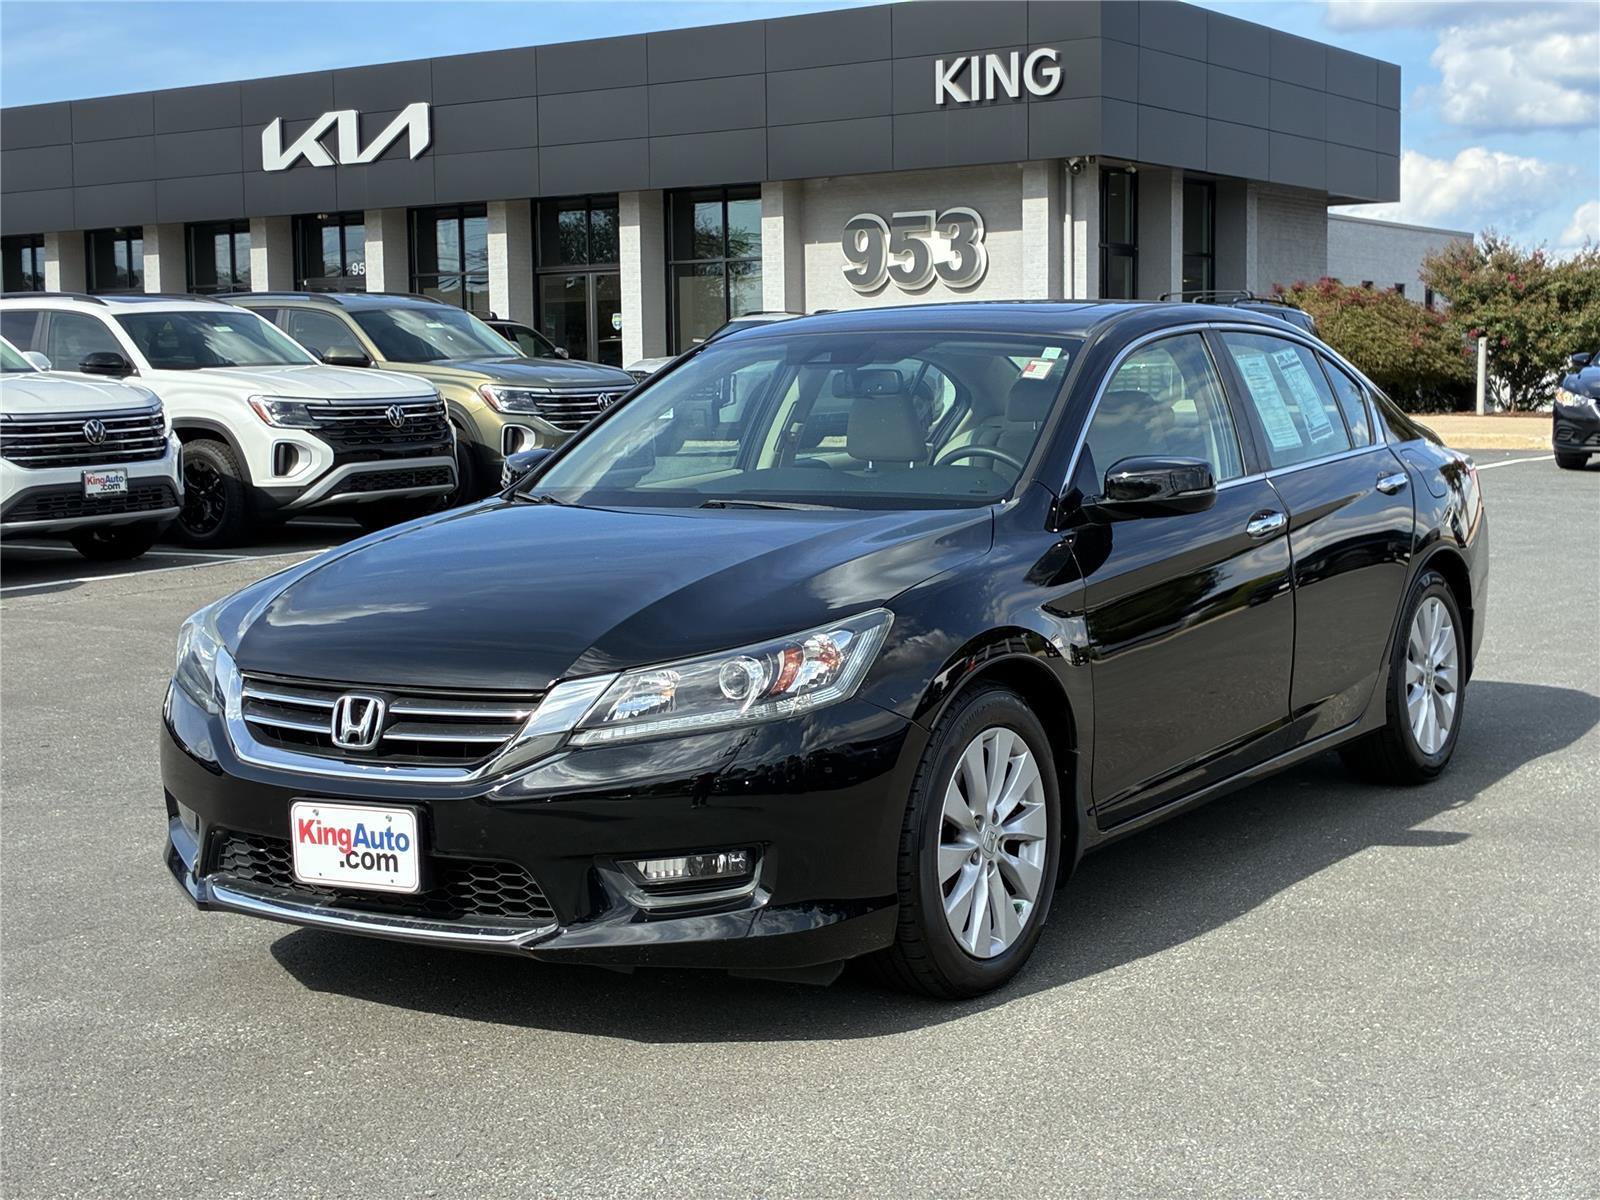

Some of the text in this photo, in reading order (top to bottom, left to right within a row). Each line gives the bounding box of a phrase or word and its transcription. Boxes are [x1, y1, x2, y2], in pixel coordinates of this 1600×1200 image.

[935, 47, 1061, 104] KING
[262, 102, 430, 171] KIA
[841, 206, 988, 293] 953
[86, 475, 124, 486] KingAuto
[100, 483, 120, 491] .com
[297, 817, 410, 854] KingAuto
[339, 850, 399, 873] .com
